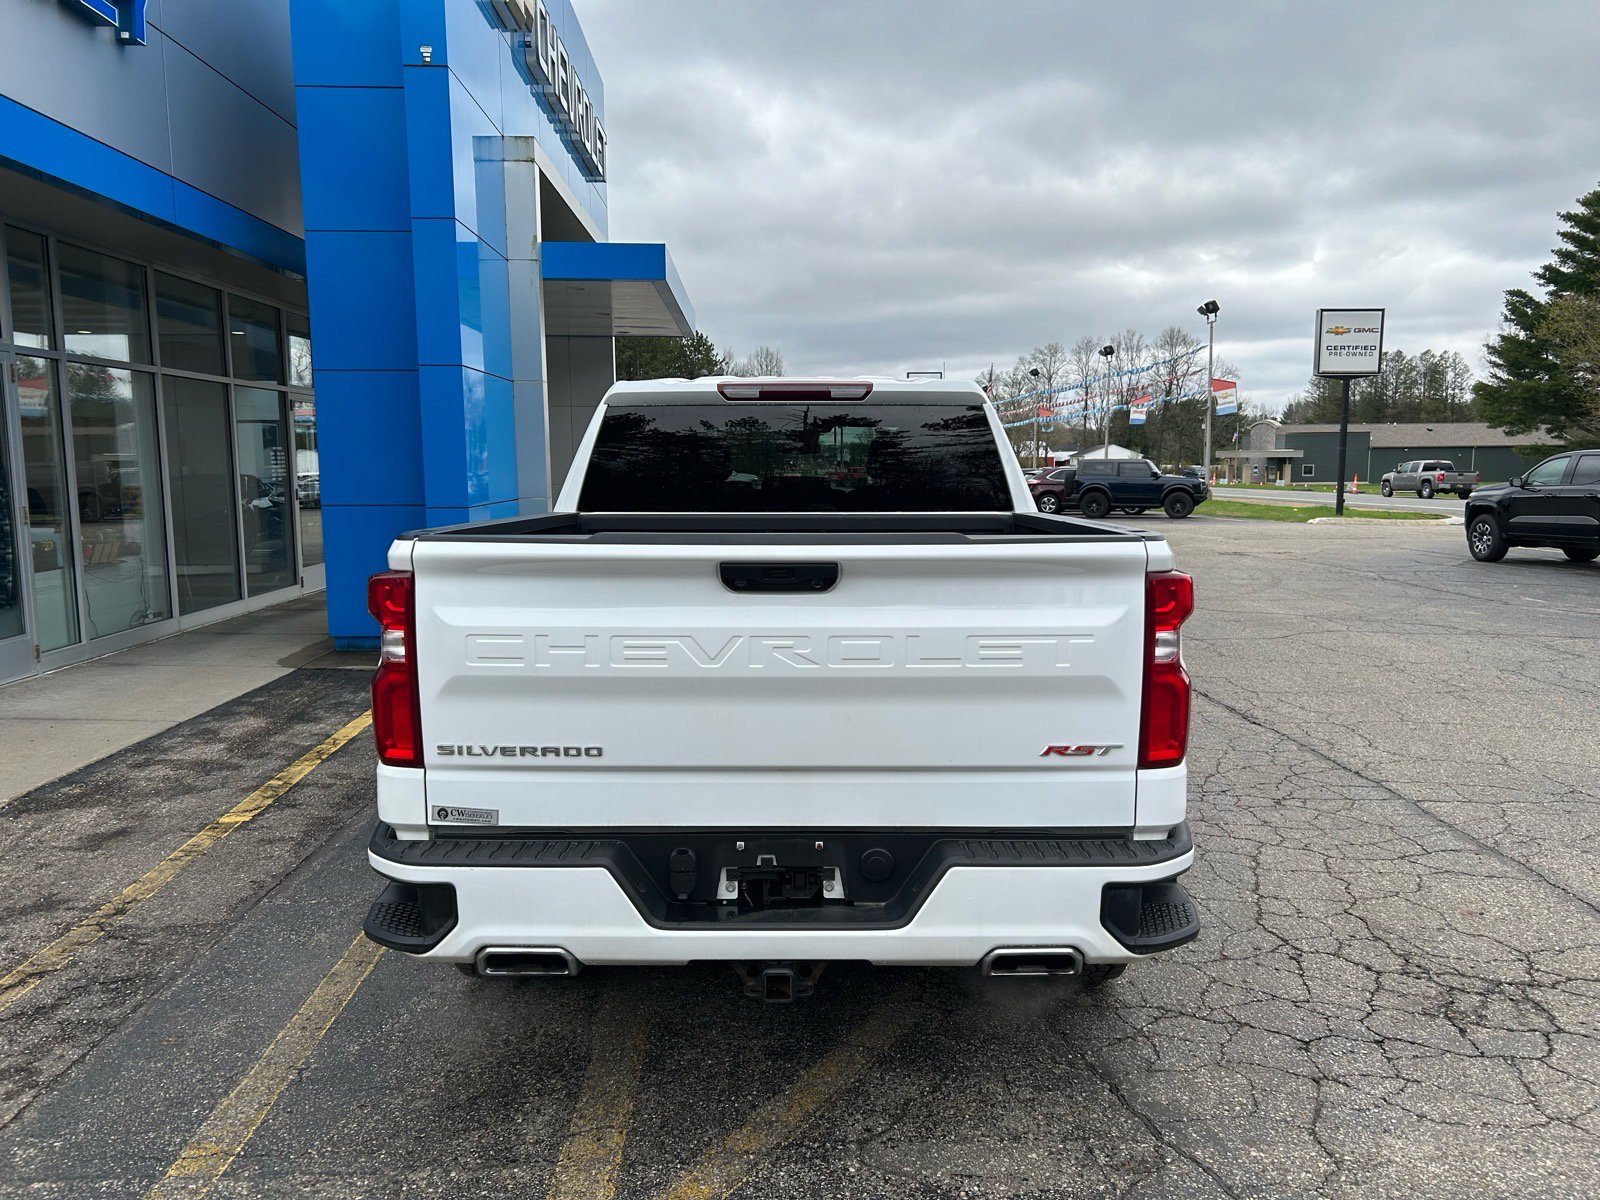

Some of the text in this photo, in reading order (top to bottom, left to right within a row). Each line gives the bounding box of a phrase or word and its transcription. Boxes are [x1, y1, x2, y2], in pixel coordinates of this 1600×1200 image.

[533, 0, 607, 181] CHEVROLET
[464, 634, 1096, 668] CHEVROLET
[436, 744, 604, 757] SILVERADO
[1038, 744, 1124, 757] RST
